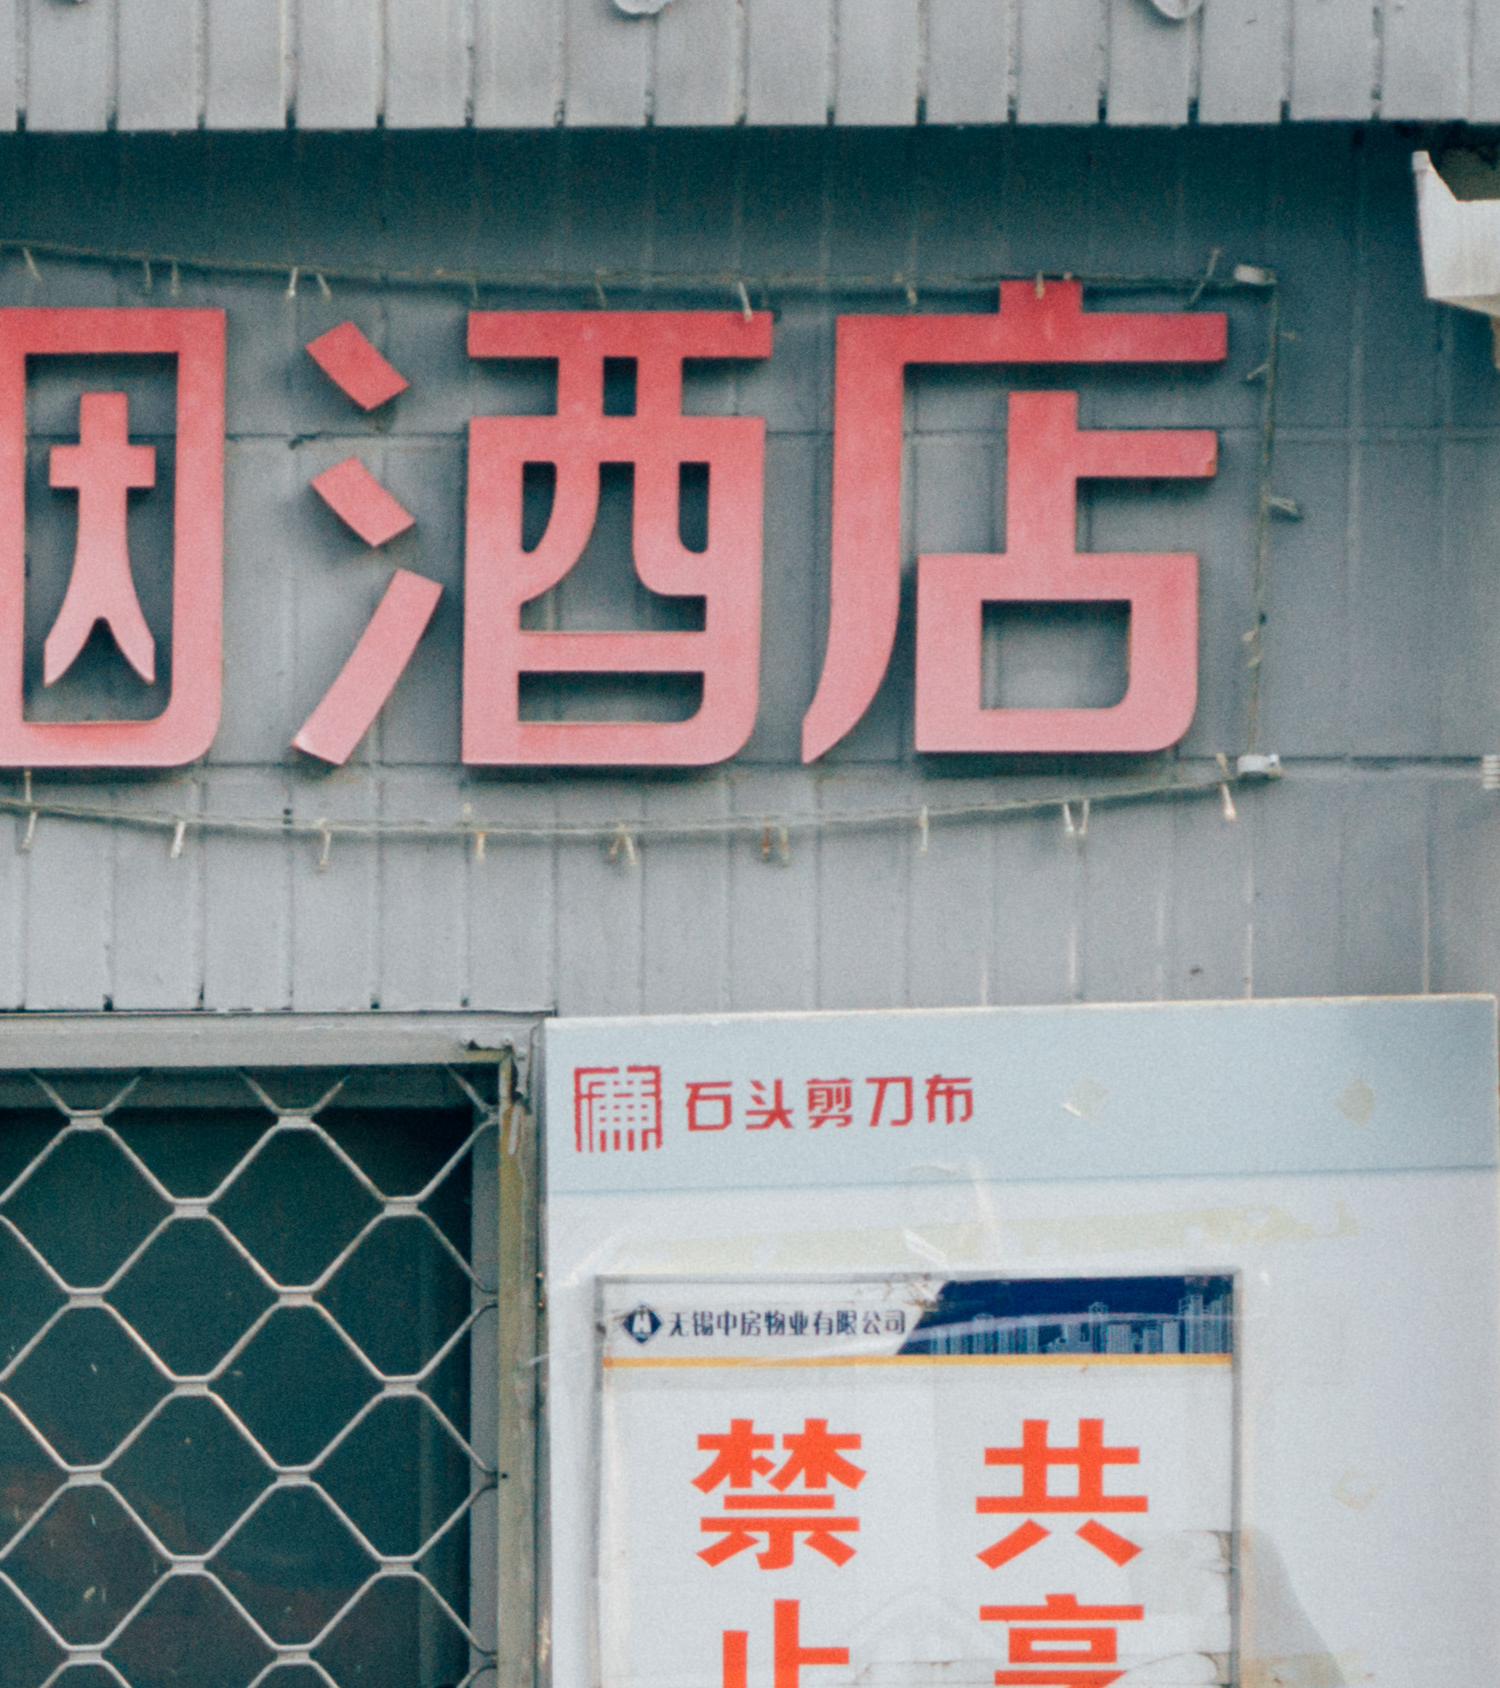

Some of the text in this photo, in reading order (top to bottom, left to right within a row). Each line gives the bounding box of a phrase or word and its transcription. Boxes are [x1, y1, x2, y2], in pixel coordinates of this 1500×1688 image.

[685, 1074, 974, 1132] 石头剪刀布
[668, 1310, 906, 1337] 无锡中房物业有限公司
